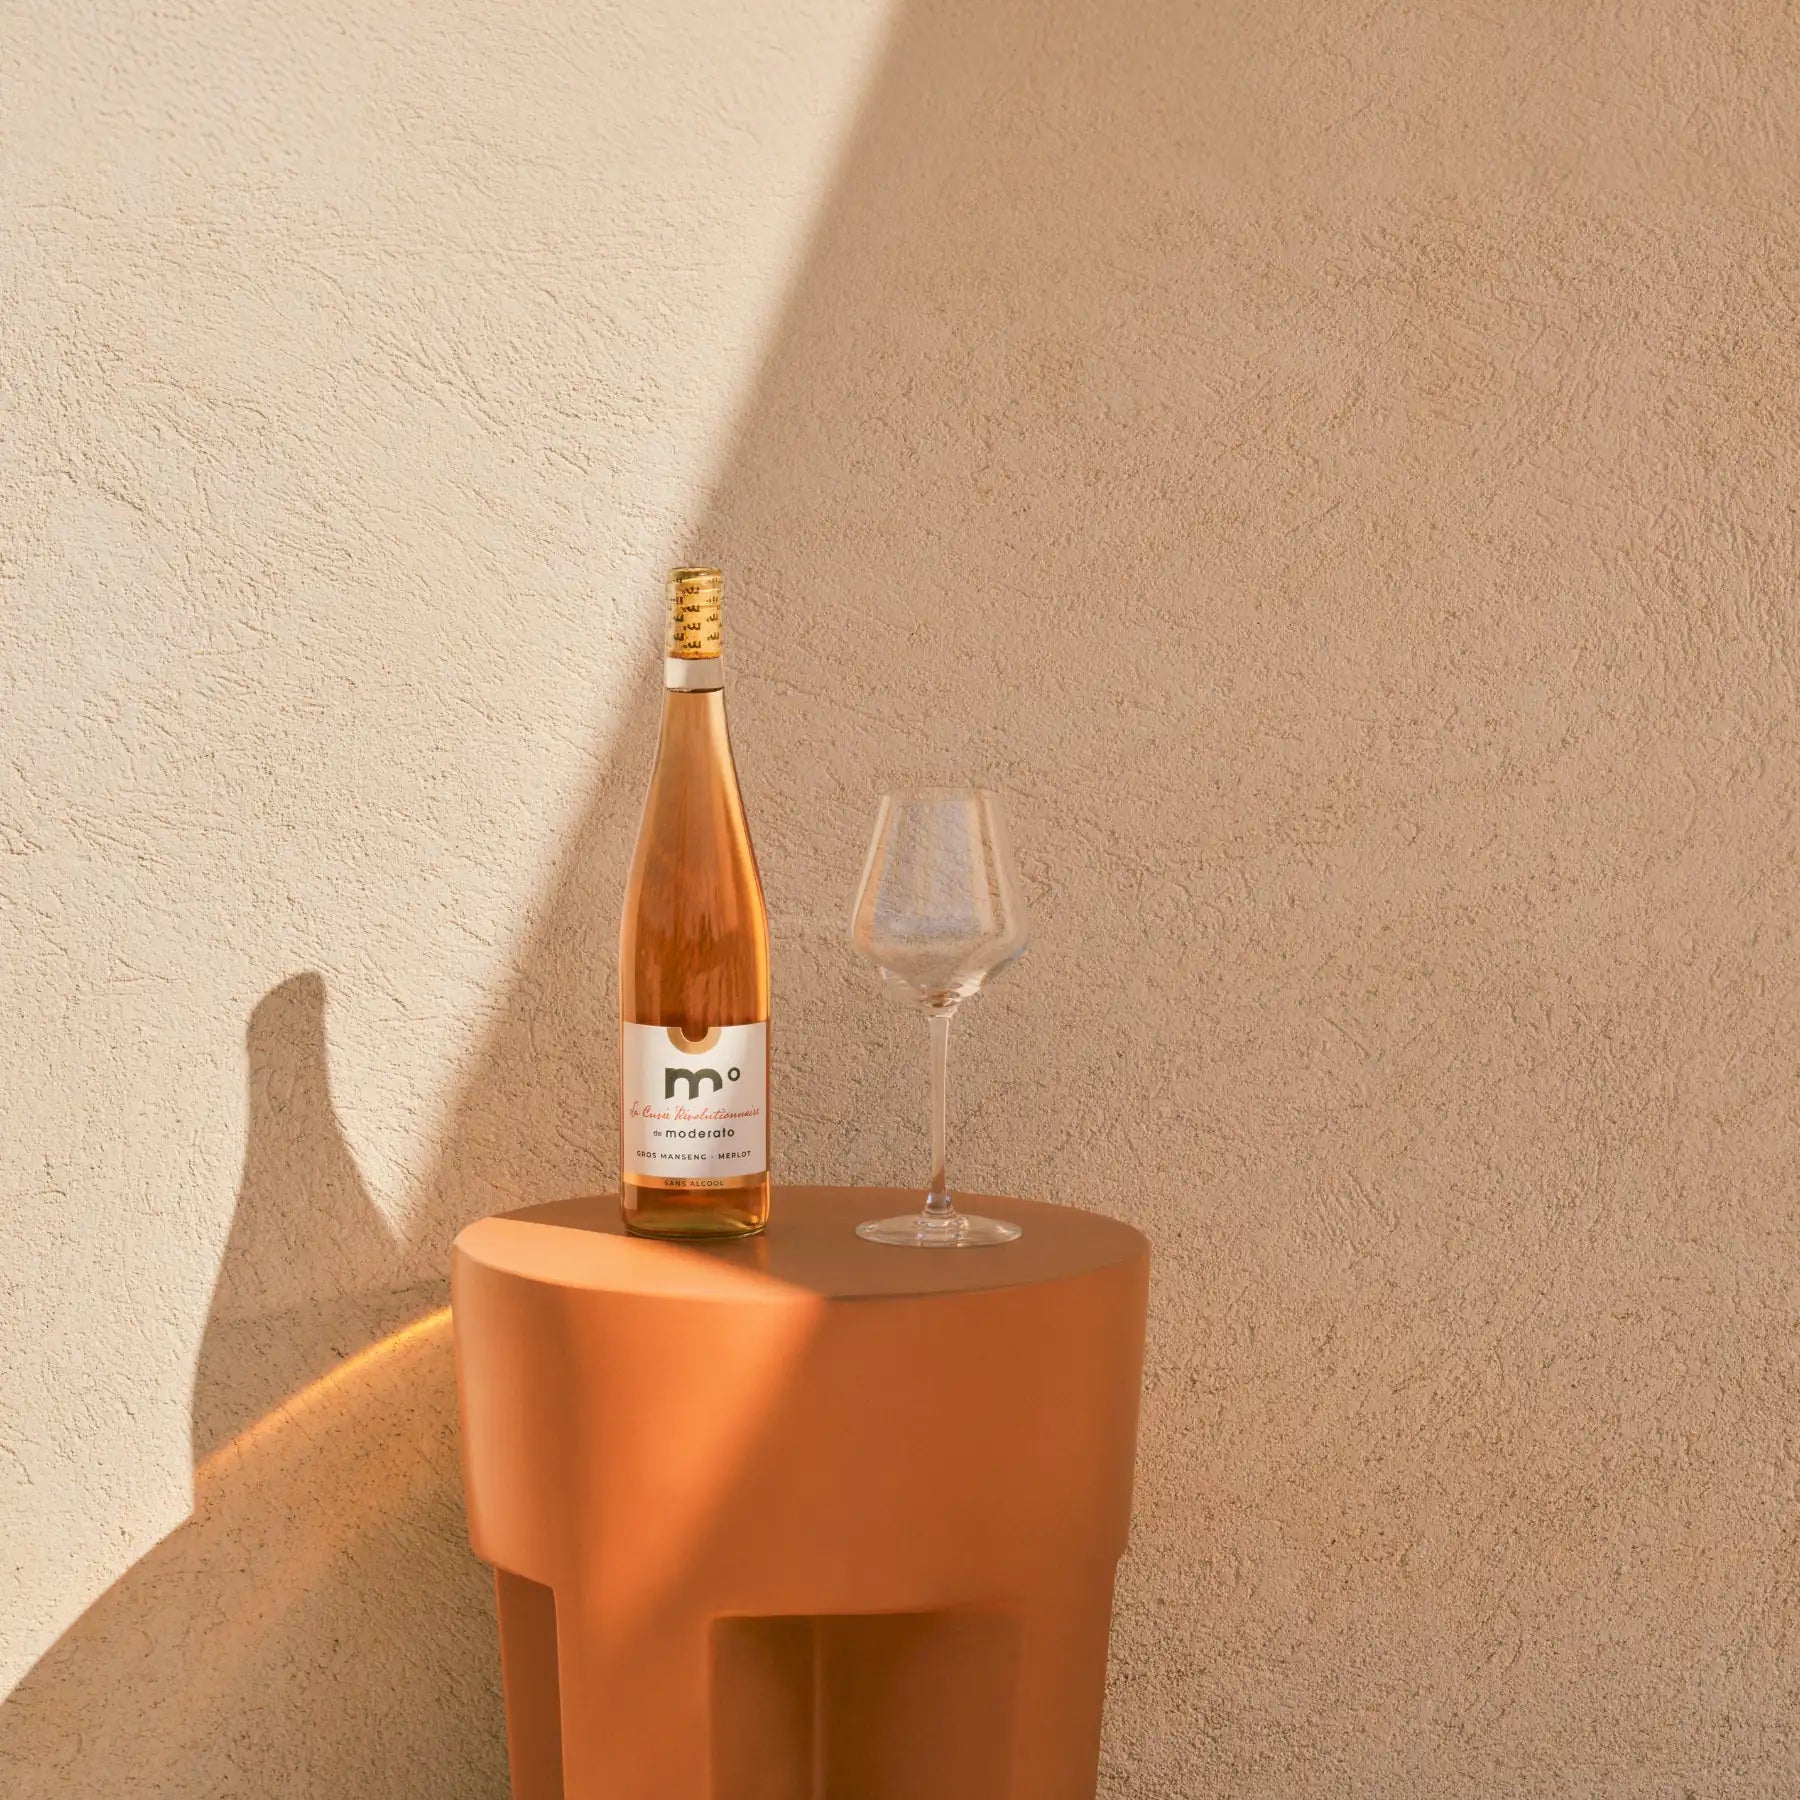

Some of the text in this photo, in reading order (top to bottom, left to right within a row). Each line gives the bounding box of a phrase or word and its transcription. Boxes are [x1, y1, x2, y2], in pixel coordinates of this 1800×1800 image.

[665, 1127, 735, 1139] moderato
[636, 1150, 657, 1159] GROS
[718, 1150, 751, 1160] MERLOT
